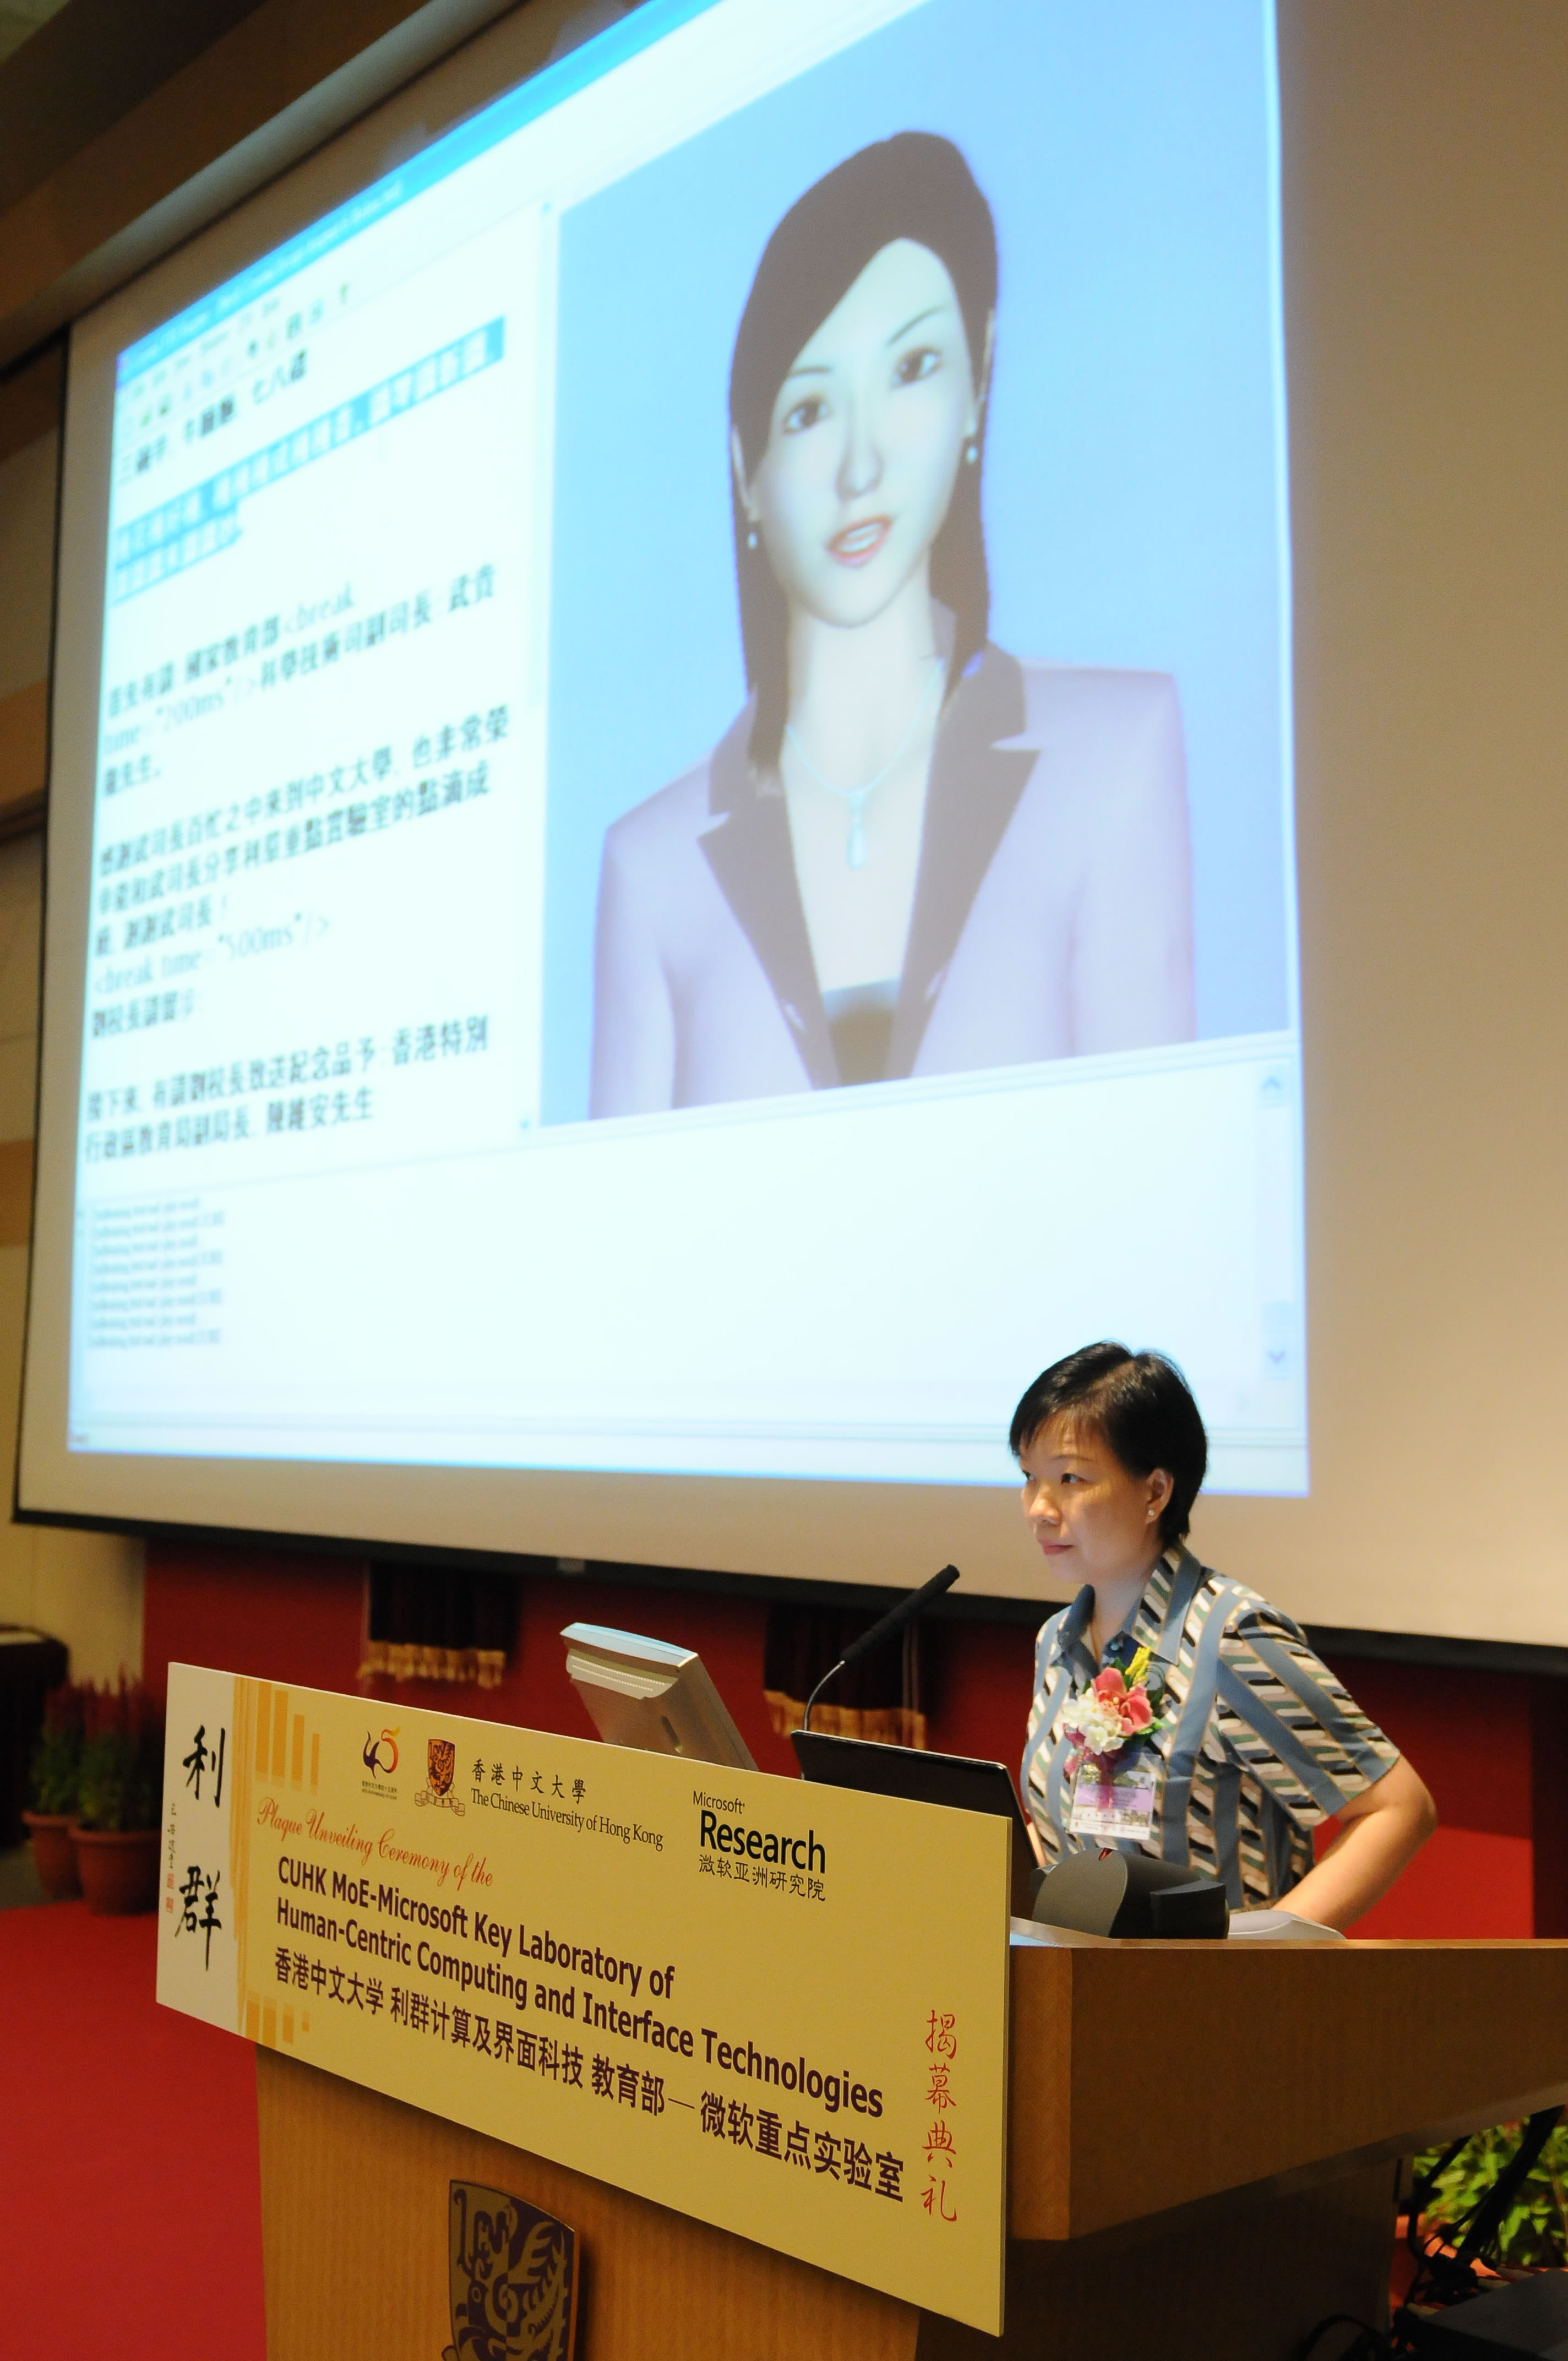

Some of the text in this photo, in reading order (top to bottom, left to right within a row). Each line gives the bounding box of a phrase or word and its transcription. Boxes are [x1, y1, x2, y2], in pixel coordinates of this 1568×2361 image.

[471, 1788, 489, 1807] The
[491, 1793, 530, 1816] Chinese
[532, 1801, 585, 1833] University
[586, 1815, 598, 1831] of
[600, 1816, 630, 1844] Hong
[633, 1824, 663, 1851] Kong
[472, 1759, 586, 1804] 香港中文大學
[257, 1797, 493, 1891] Plaque Unveiling Ceremony of the
[699, 1854, 826, 1902] 微软亚洲研究院
[700, 1809, 825, 1874] Research
[279, 1856, 676, 1999] CUHK MoE-Microsoft Key Laboratory of
[275, 1946, 384, 2015] 香港中文大学
[390, 1987, 584, 2090] 利群计算及界面科技
[277, 1897, 883, 2118] Human-Centric Computing and Interface Technologies
